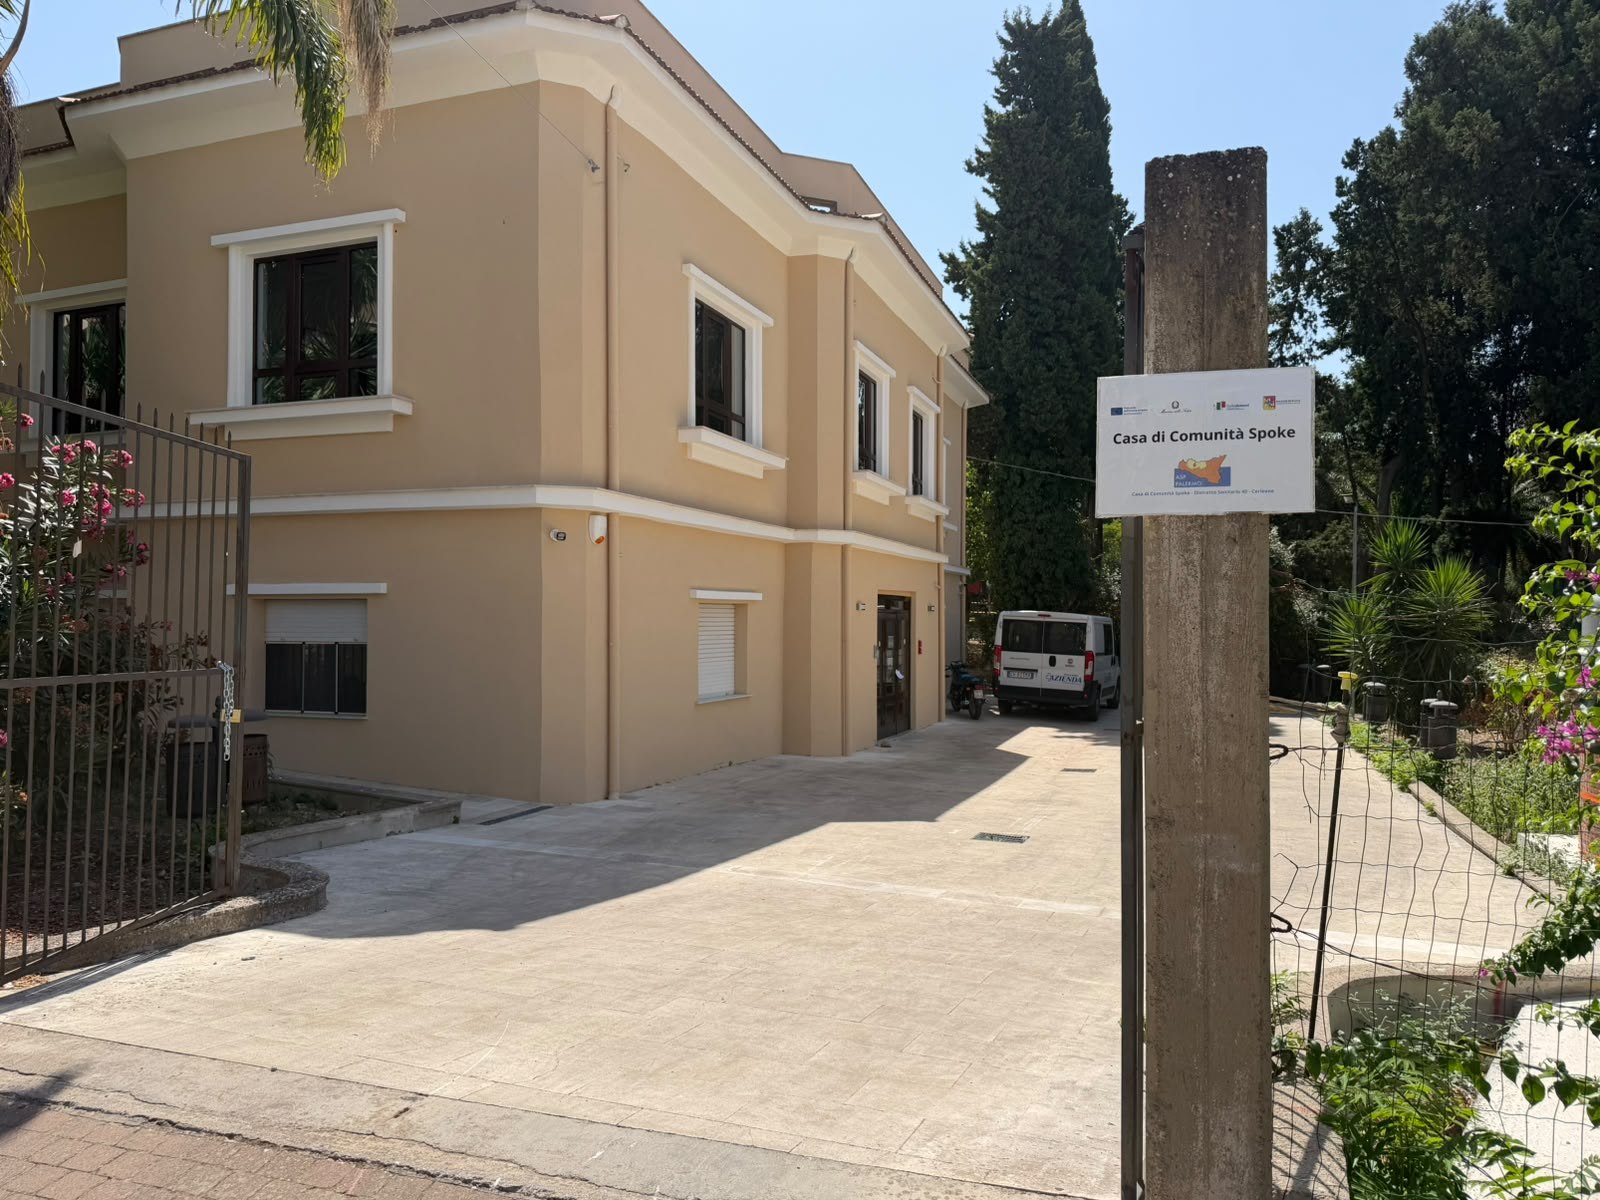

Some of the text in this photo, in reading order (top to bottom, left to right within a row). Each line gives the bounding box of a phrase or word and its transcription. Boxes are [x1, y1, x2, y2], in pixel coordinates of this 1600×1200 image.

[1113, 426, 1296, 445] Casa di Comunità Spoke
[1050, 675, 1082, 683] AZIENDA
